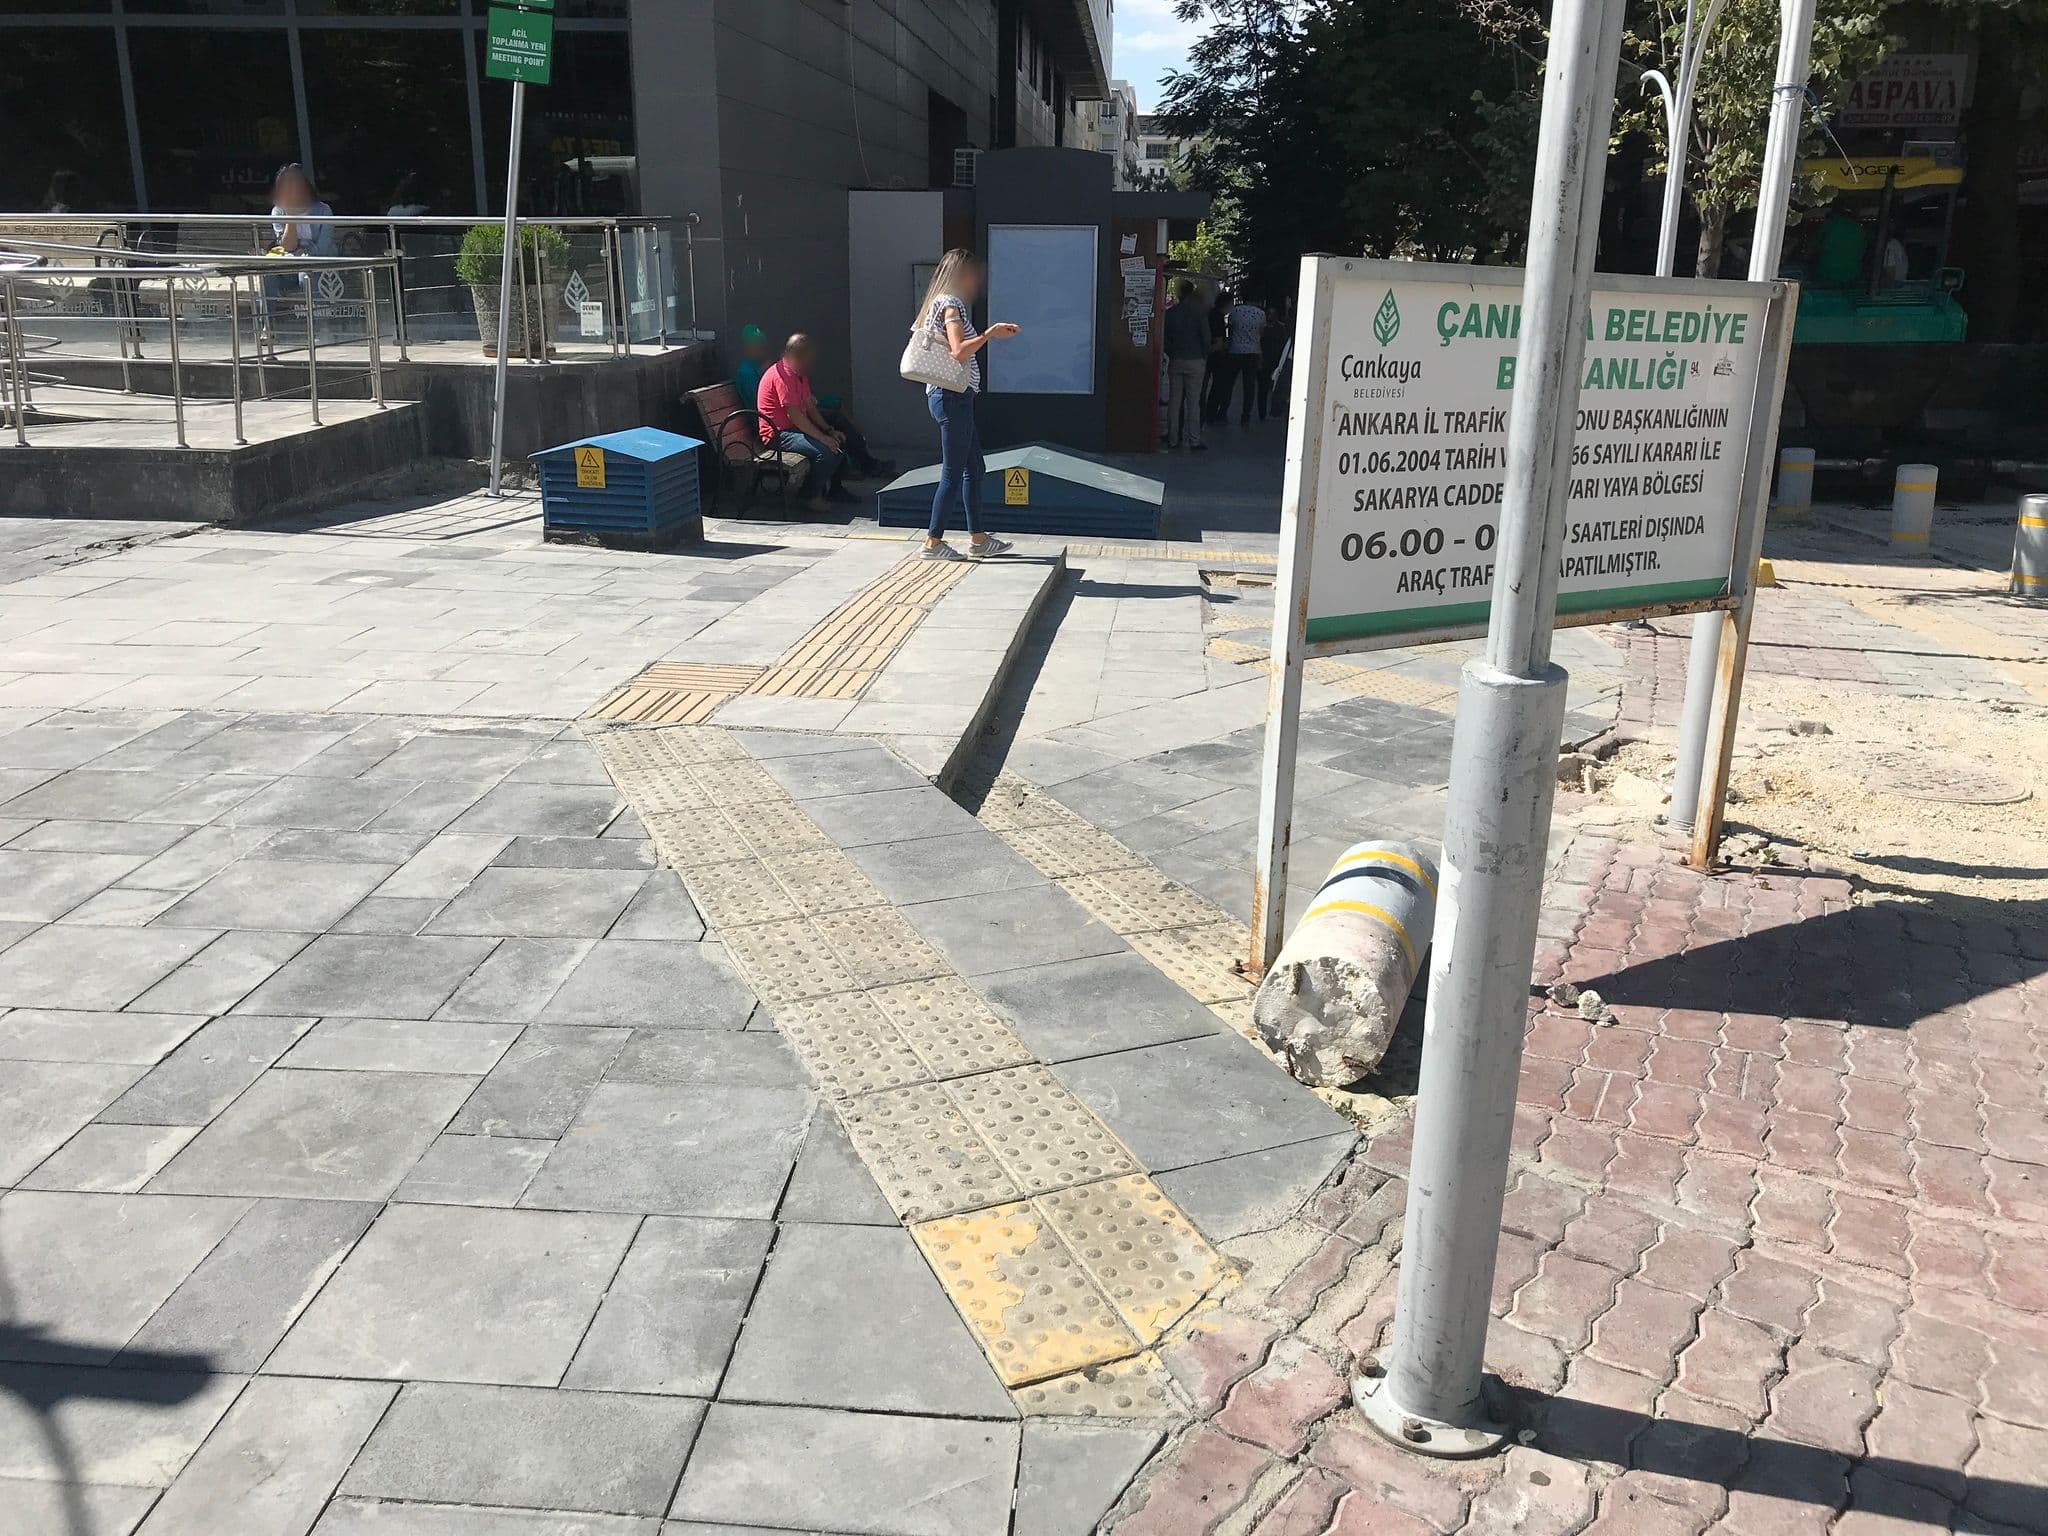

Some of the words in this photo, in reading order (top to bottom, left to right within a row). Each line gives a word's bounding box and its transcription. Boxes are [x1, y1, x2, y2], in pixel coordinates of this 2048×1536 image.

[492, 36, 528, 48] TOPLANMA
[492, 52, 522, 63] MEETING
[524, 57, 544, 66] POINT
[1840, 164, 1905, 176] VÖGEE
[1604, 304, 1748, 344] BELEDİYE
[1341, 354, 1422, 384] Çankaya
[1354, 386, 1406, 398] BELEDİYESİ
[1338, 412, 1419, 436] ANKARA
[1424, 407, 1439, 434] İL
[1444, 406, 1506, 433] TRAFİK
[1613, 404, 1729, 435] BAŞKANLIĞININ
[1338, 449, 1440, 474] 01.06.2004
[1445, 443, 1495, 471] TARİH
[1593, 443, 1639, 464] SAYILI
[1643, 441, 1697, 463] KARARI
[1700, 437, 1722, 460] İLE
[1353, 486, 1438, 512] SAKARYA
[1444, 483, 1504, 506] CADDE
[1604, 476, 1639, 497] YAYA
[1643, 469, 1704, 495] BÖLGESİ
[1341, 527, 1444, 561] 06.00
[1571, 515, 1643, 544] SAATLERİ
[1645, 515, 1704, 541] DIŞINDA
[1396, 568, 1446, 595] ARAÇ
[1450, 565, 1494, 588] TRAF
